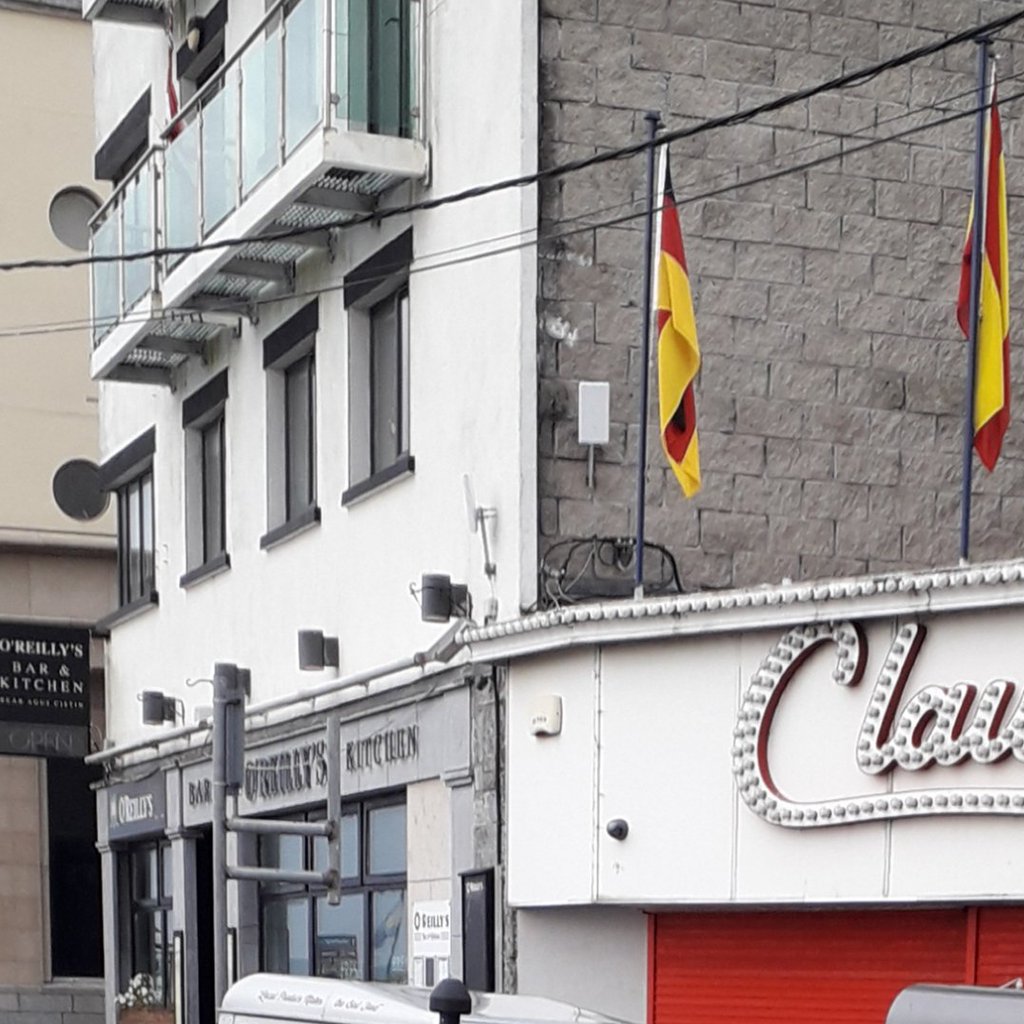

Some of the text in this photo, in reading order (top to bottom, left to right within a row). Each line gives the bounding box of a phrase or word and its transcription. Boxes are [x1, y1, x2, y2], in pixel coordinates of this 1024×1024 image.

[0, 639, 84, 658] O'REILLY'S
[12, 661, 71, 677] BAR &
[0, 676, 84, 693] KITCHEN
[345, 724, 420, 772] KITCHEN
